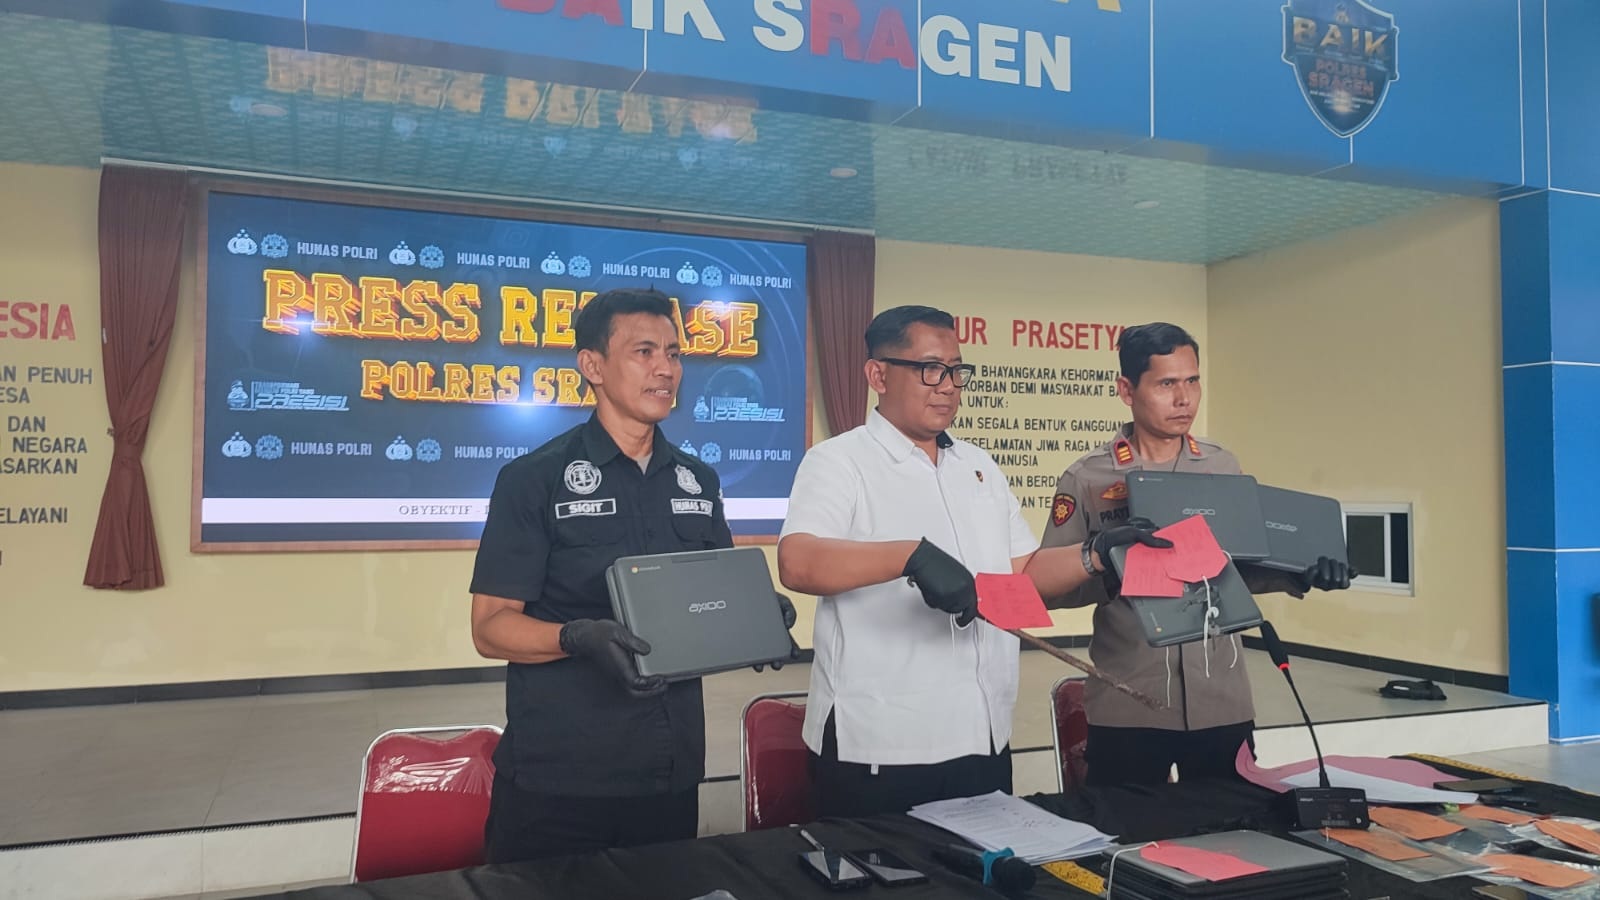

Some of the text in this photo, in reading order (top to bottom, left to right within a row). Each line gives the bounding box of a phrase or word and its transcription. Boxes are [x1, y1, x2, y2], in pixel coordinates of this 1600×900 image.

[1293, 16, 1389, 57] BAIK
[496, 0, 1071, 92] IK SRAGEN
[297, 242, 378, 260] HUMAS POLRI
[457, 252, 530, 269] HUMAS POLRI
[603, 263, 670, 279] HUMAS POLRI
[730, 273, 792, 289] HUMAS POLRI
[262, 269, 482, 344] PRESS
[0, 366, 93, 385] N PENUH
[981, 365, 1057, 380] BHAYANGKARA
[360, 359, 521, 404] POLRES
[961, 380, 1007, 394] KORBAN
[1011, 381, 1037, 394] DEMI
[1041, 382, 1104, 397] MASYARAKAT
[967, 396, 1009, 409] UNTUK:
[8, 415, 46, 433] DAN
[977, 417, 1019, 430] SEGALA
[1024, 418, 1067, 431] BENTUK
[13, 436, 88, 454] NEGARA
[291, 442, 372, 456] HUMAS POLRI
[454, 446, 493, 459] HUMAS
[1036, 440, 1060, 452] JIWA
[1065, 440, 1090, 452] RAGA
[729, 449, 791, 462] HUMAS POLRI
[991, 454, 1039, 467] MANUSIA
[0, 457, 78, 475] SARKAN
[398, 504, 473, 516] OBYEKTIF
[568, 502, 603, 515] SIGIT
[1016, 496, 1035, 509] AN
